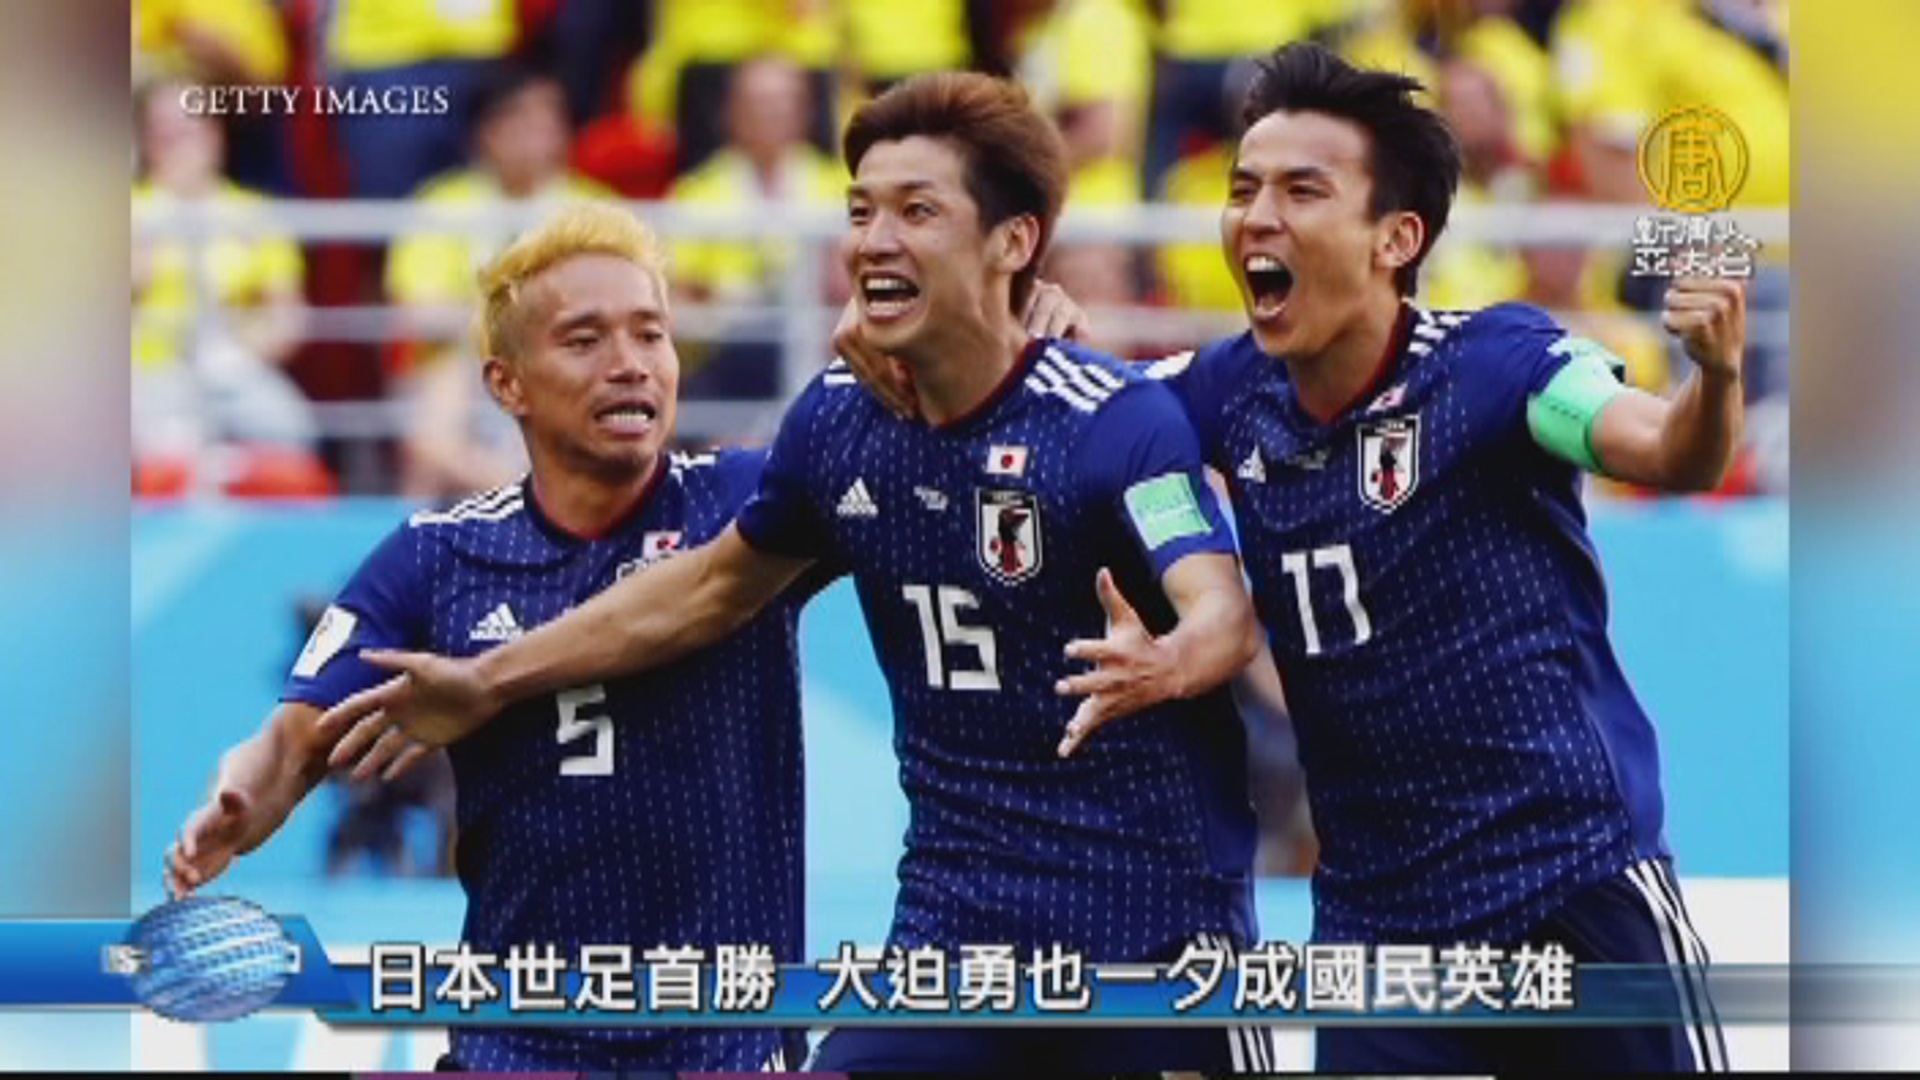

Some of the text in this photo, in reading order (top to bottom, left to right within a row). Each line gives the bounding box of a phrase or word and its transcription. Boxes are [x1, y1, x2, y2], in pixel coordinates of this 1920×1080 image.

[902, 584, 1001, 691] 15
[1280, 543, 1373, 655] 17
[556, 683, 615, 776] 5
